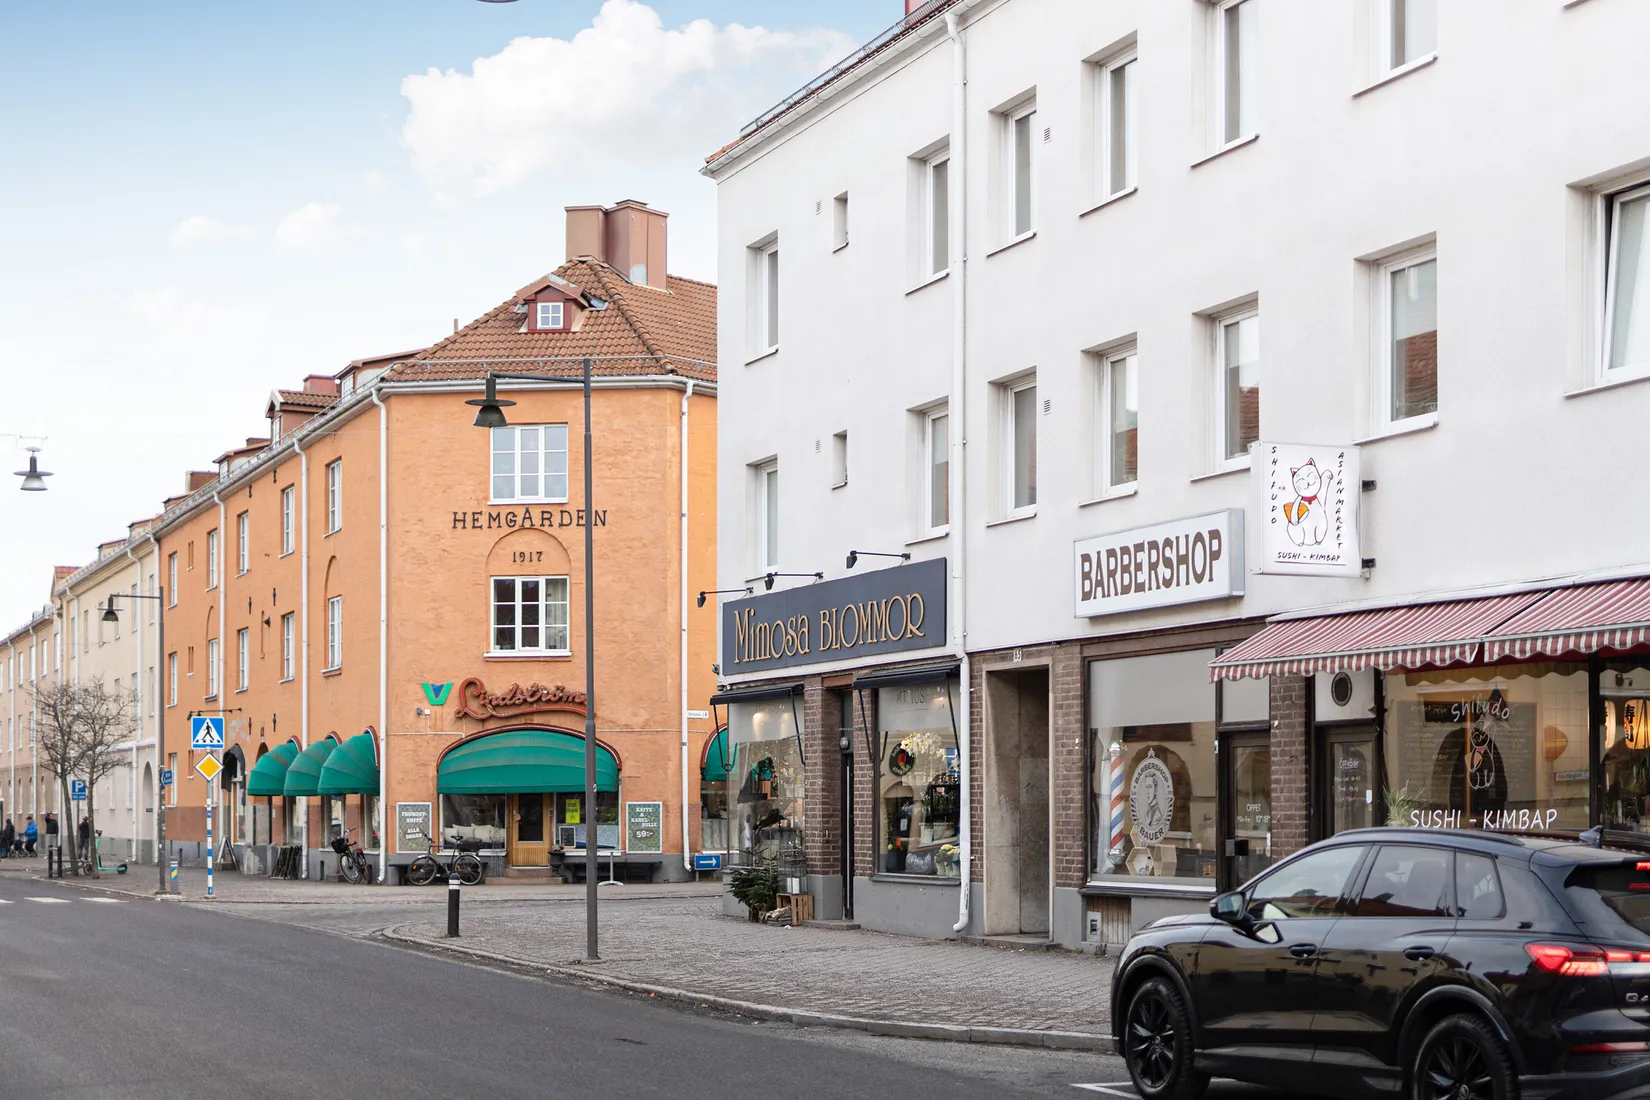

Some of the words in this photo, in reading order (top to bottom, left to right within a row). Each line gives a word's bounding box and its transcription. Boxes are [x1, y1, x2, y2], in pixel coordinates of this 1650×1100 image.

[1336, 452, 1345, 494] ASIAN
[452, 506, 607, 530] HEMGÅRDEN
[1335, 499, 1345, 548] MARKET
[512, 551, 543, 563] 1917
[1080, 528, 1222, 602] BARBERSHOP
[1277, 551, 1301, 559] SUSHI
[1309, 553, 1341, 562] KIMBAP
[733, 607, 810, 664] Mimosa
[819, 592, 926, 651] BLOMMOR
[454, 677, 587, 720] Lindström
[1135, 762, 1169, 784] BARBERSHOP
[75, 781, 84, 792] P
[1410, 809, 1461, 829] SUSHI
[1483, 808, 1558, 830] KIMBAP
[636, 830, 654, 838] 59:-
[1140, 826, 1164, 840] BAUER
